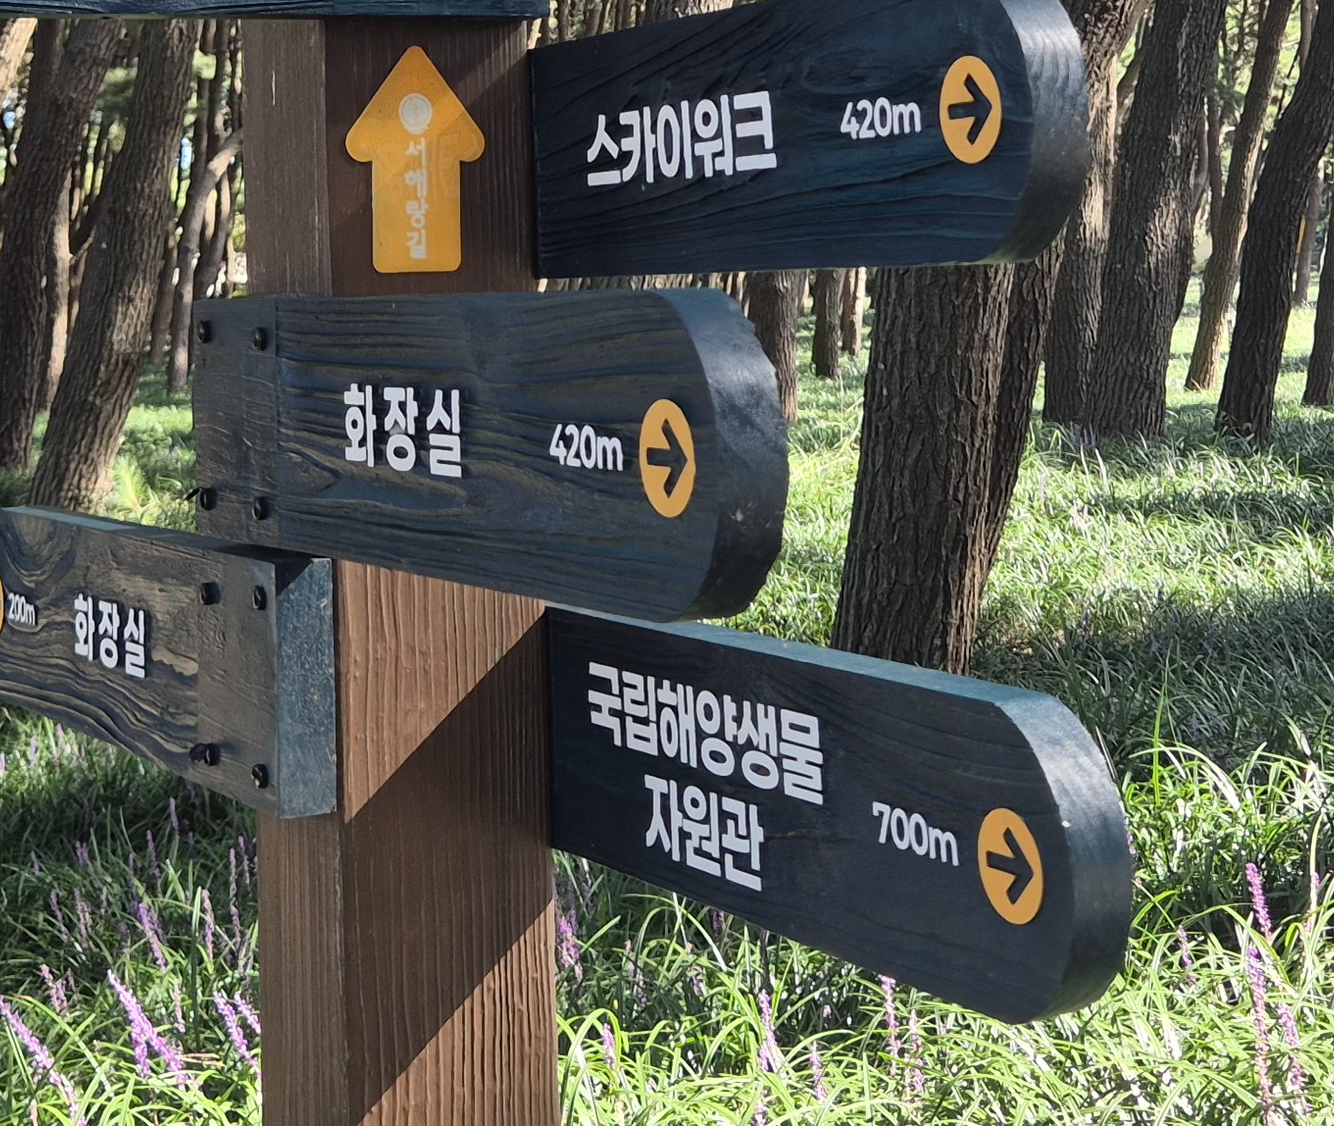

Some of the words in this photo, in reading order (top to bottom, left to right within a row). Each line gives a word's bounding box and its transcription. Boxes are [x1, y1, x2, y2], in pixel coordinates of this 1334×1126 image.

[586, 90, 777, 186] 스카이워크
[840, 97, 922, 141] 420m
[404, 136, 429, 260] 서해랑길
[343, 383, 463, 477] 화장실
[548, 423, 623, 472] 420m
[7, 591, 36, 626] 200m
[74, 592, 146, 678] 화장실
[587, 661, 824, 805] 국립해양생물
[643, 774, 765, 892] 자원관
[872, 801, 960, 867] 700m
